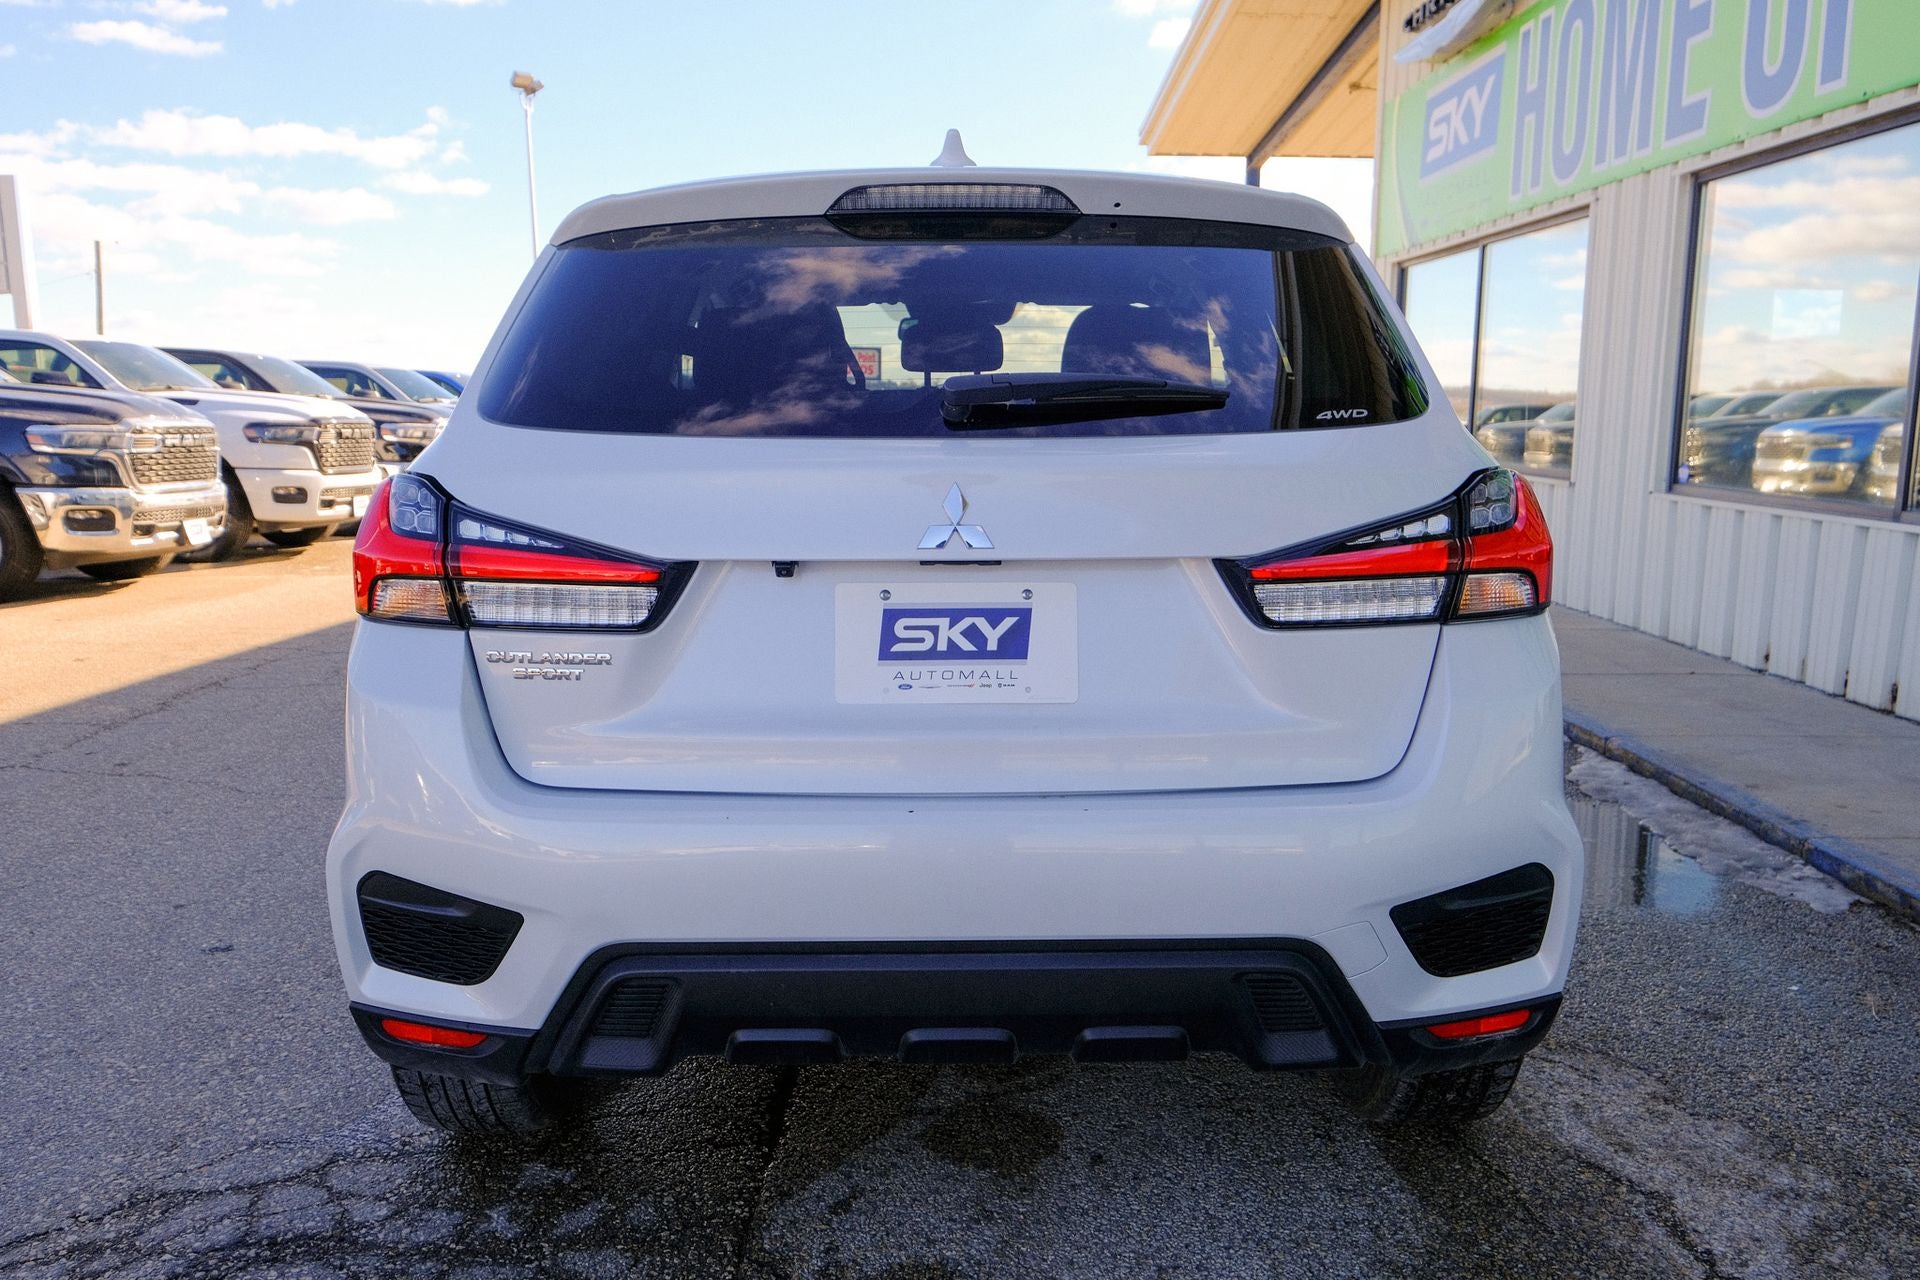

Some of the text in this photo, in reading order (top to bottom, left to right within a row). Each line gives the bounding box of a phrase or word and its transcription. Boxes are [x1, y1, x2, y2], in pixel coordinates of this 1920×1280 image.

[1509, 0, 1714, 200] HOME
[1426, 73, 1497, 163] SKY
[1316, 409, 1368, 420] 4WD
[890, 616, 1020, 652] SKY
[486, 651, 612, 665] OUTLANDER
[512, 667, 584, 681] SPORT
[893, 670, 1018, 681] AUTOMALL
